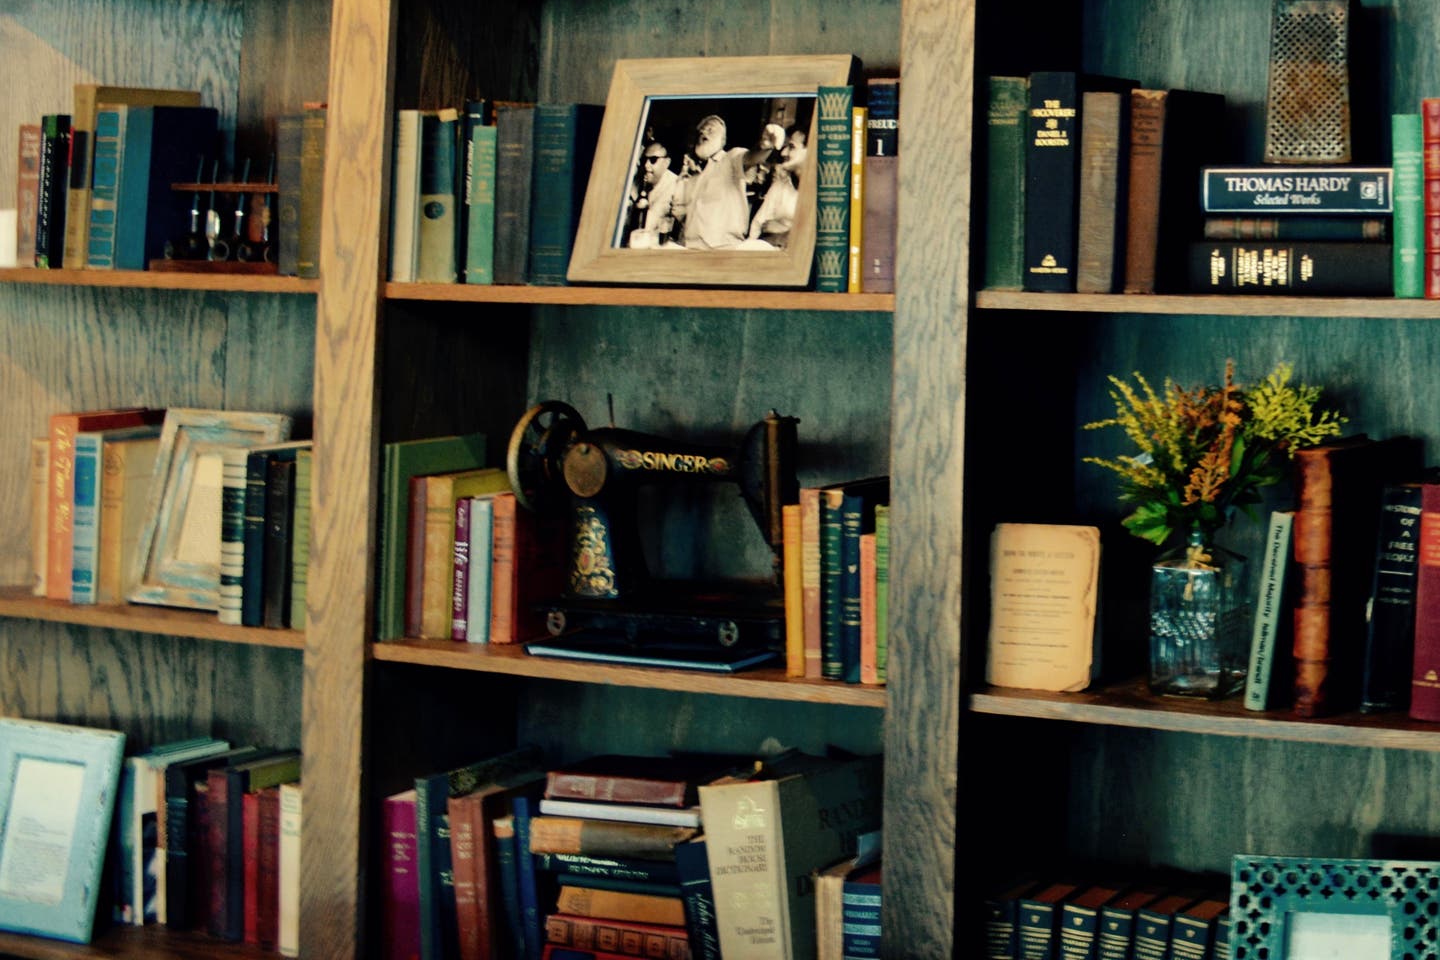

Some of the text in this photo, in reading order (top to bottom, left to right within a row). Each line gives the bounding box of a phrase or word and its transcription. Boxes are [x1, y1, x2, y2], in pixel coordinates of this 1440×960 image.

[1043, 100, 1061, 108] THE
[1225, 177, 1351, 192] THOMAS HARDY
[1253, 193, 1321, 205] Selected Works
[642, 451, 708, 473] SINGER
[1400, 518, 1414, 527] OF
[1388, 542, 1414, 551] FREE
[1269, 542, 1281, 581] Deceived
[1263, 583, 1275, 618] Majority
